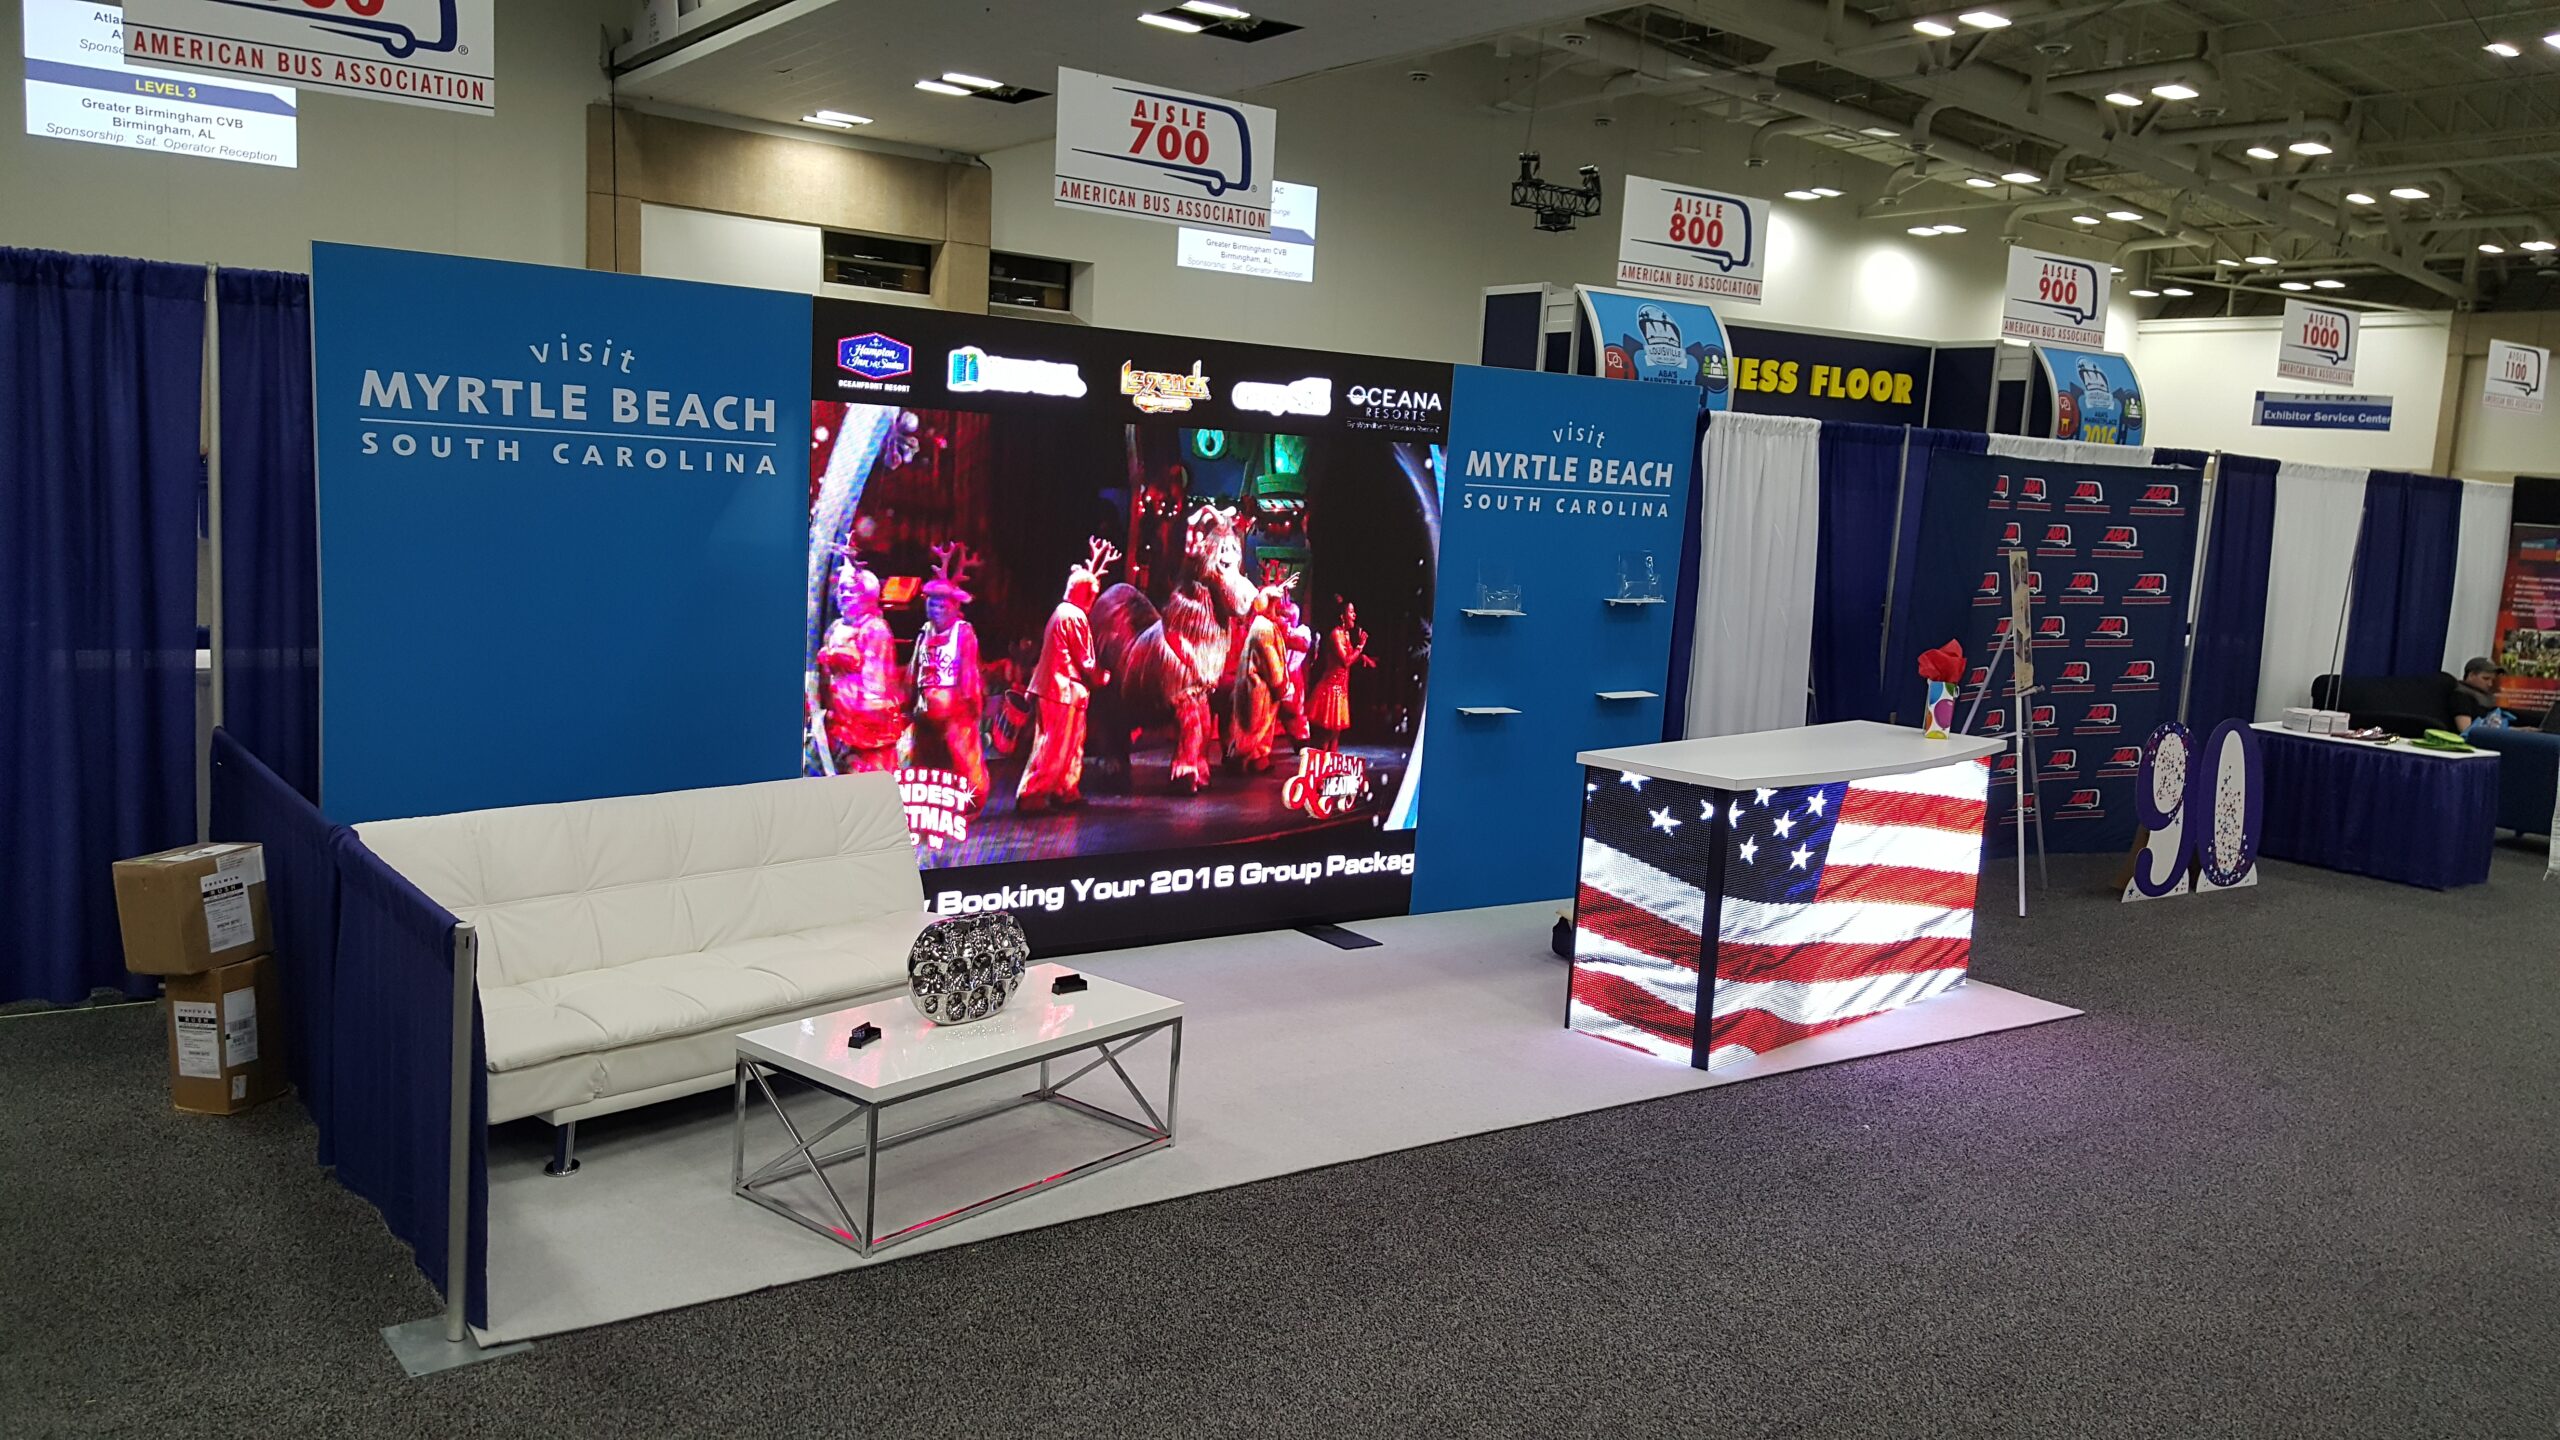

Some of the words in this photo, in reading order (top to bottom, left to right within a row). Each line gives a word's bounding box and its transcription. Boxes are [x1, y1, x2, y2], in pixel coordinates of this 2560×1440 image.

[134, 30, 264, 69] AMERICAN
[278, 52, 322, 77] BUS
[335, 60, 485, 102] ASSOCIATION
[135, 79, 184, 97] LEVEL
[187, 87, 197, 99] 3
[81, 97, 131, 114] Greater
[135, 105, 212, 126] Birmingham
[216, 115, 244, 129] CVB
[1134, 99, 1207, 129] AISLE
[112, 117, 195, 138] Birmingham,
[198, 128, 216, 140] AL
[1129, 118, 1209, 165] 700
[164, 138, 216, 156] Operator
[219, 145, 278, 162] Reception
[1060, 181, 1136, 208] AMERICAN
[1143, 194, 1170, 213] BUS
[1176, 199, 1266, 228] ASSOCIATION
[1674, 197, 1723, 219] AISLE
[1669, 213, 1724, 248] 800
[1206, 238, 1232, 250] Greater
[1232, 242, 1272, 254] Birmingham
[1273, 247, 1287, 256] CVB
[1621, 265, 1672, 285] AMERICAN
[1675, 272, 1695, 288] BUS
[1698, 276, 1759, 296] ASSOCIATION
[2042, 263, 2077, 280] AISLE
[2039, 277, 2077, 305] 900
[2005, 319, 2040, 335] AMERICAN
[2042, 326, 2056, 338] BUS
[2058, 329, 2103, 345] ASSOCIATION
[2308, 312, 2335, 328] AISLE
[2303, 324, 2340, 349] 1000
[528, 333, 636, 374] visit
[1810, 364, 1913, 404] FLOOR
[2505, 361, 2527, 381] 1100
[359, 368, 588, 421] MYRTLE
[612, 387, 776, 433] BEACH
[1346, 385, 1442, 411] OCEANA
[1365, 406, 1426, 422] RESORTS
[2264, 409, 2312, 421] Exhibitor
[2313, 411, 2355, 423] Service
[2358, 412, 2391, 424] Center
[1552, 421, 1605, 449] visit
[361, 431, 520, 462] SOUTH
[552, 442, 777, 475] CAROLINA
[1465, 450, 1579, 483] MYRTLE
[1588, 457, 1674, 488] BEACH
[1463, 493, 1541, 513] SOUTH
[1555, 498, 1669, 518] CAROLINA
[894, 769, 968, 790] SOUTH'S
[937, 883, 1066, 915] Booking
[1070, 877, 1145, 902] Your
[1150, 864, 1235, 895] 2016
[1240, 861, 1322, 885] Group
[1326, 851, 1416, 877] Packag
